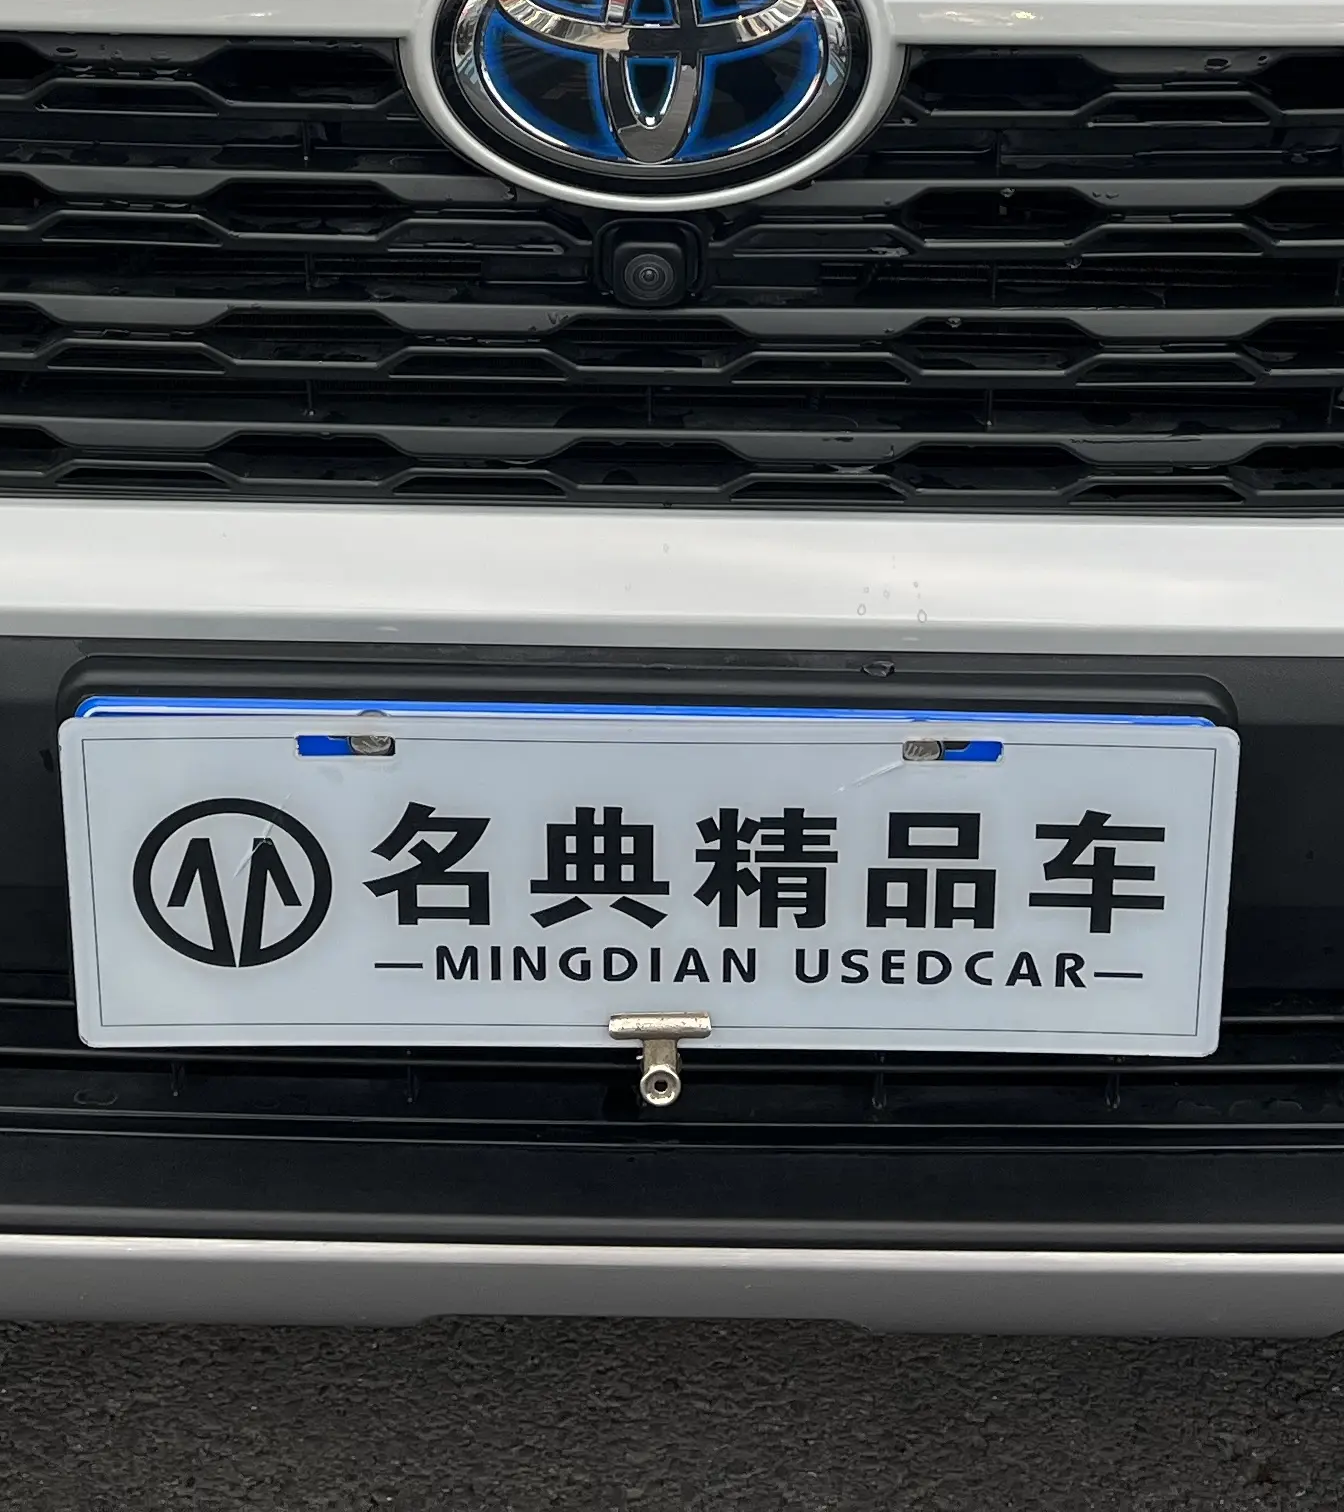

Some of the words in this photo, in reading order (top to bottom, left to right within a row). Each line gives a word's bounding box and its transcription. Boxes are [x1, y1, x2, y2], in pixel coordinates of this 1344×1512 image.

[363, 802, 1166, 933] 名典精品车
[436, 945, 756, 983] MINGDIAN
[795, 948, 1086, 988] USEDCAR
